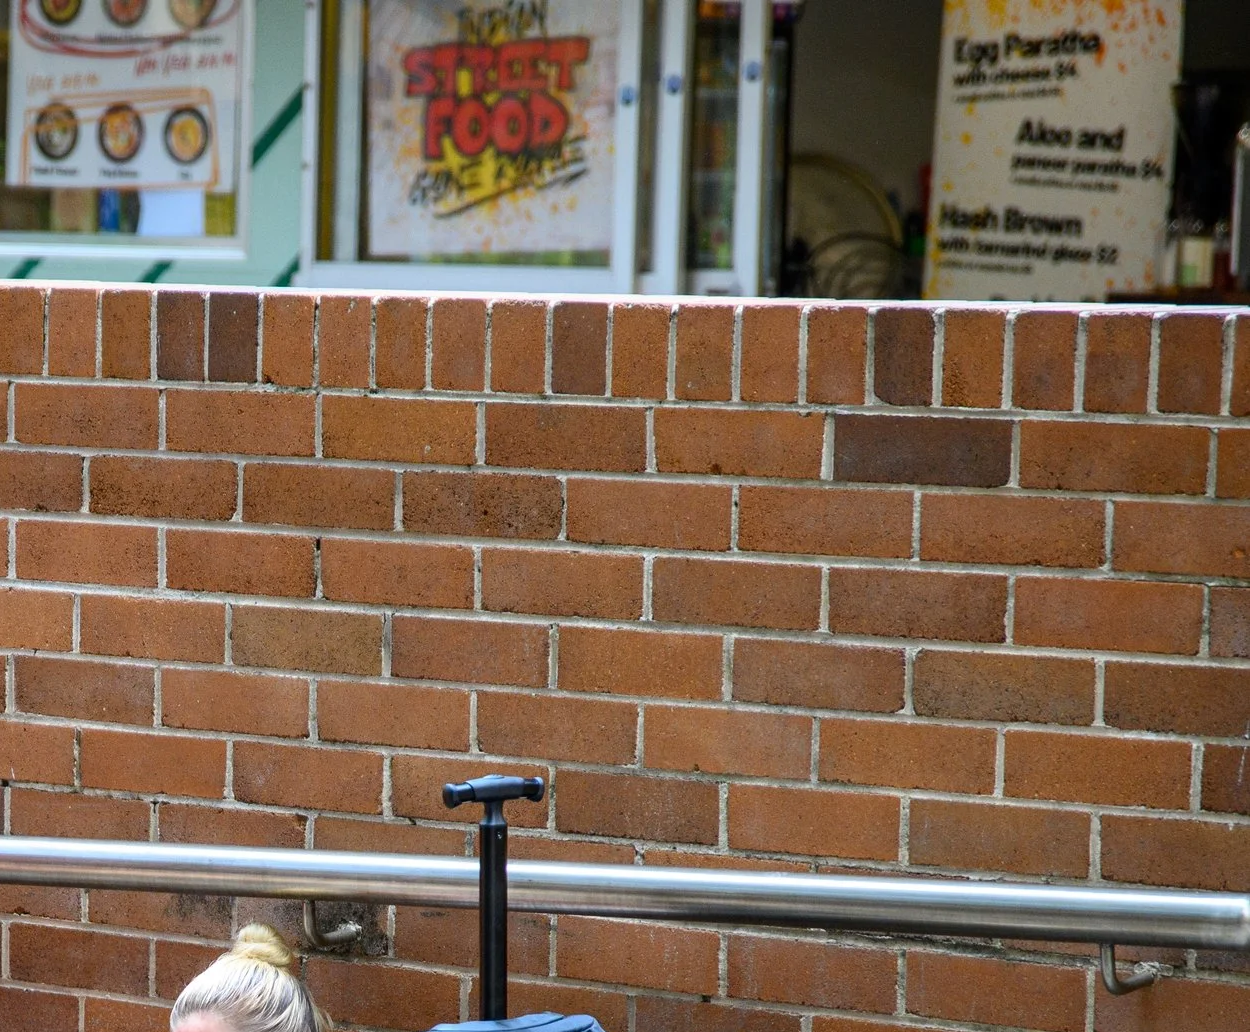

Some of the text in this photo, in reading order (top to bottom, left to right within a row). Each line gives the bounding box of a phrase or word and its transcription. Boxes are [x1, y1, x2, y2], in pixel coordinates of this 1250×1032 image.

[403, 36, 590, 98] STREET
[954, 32, 1100, 67] Egg Paratha
[424, 93, 570, 161] FOOD
[1014, 119, 1126, 153] Aloo and
[938, 203, 1083, 238] Hash Brown
